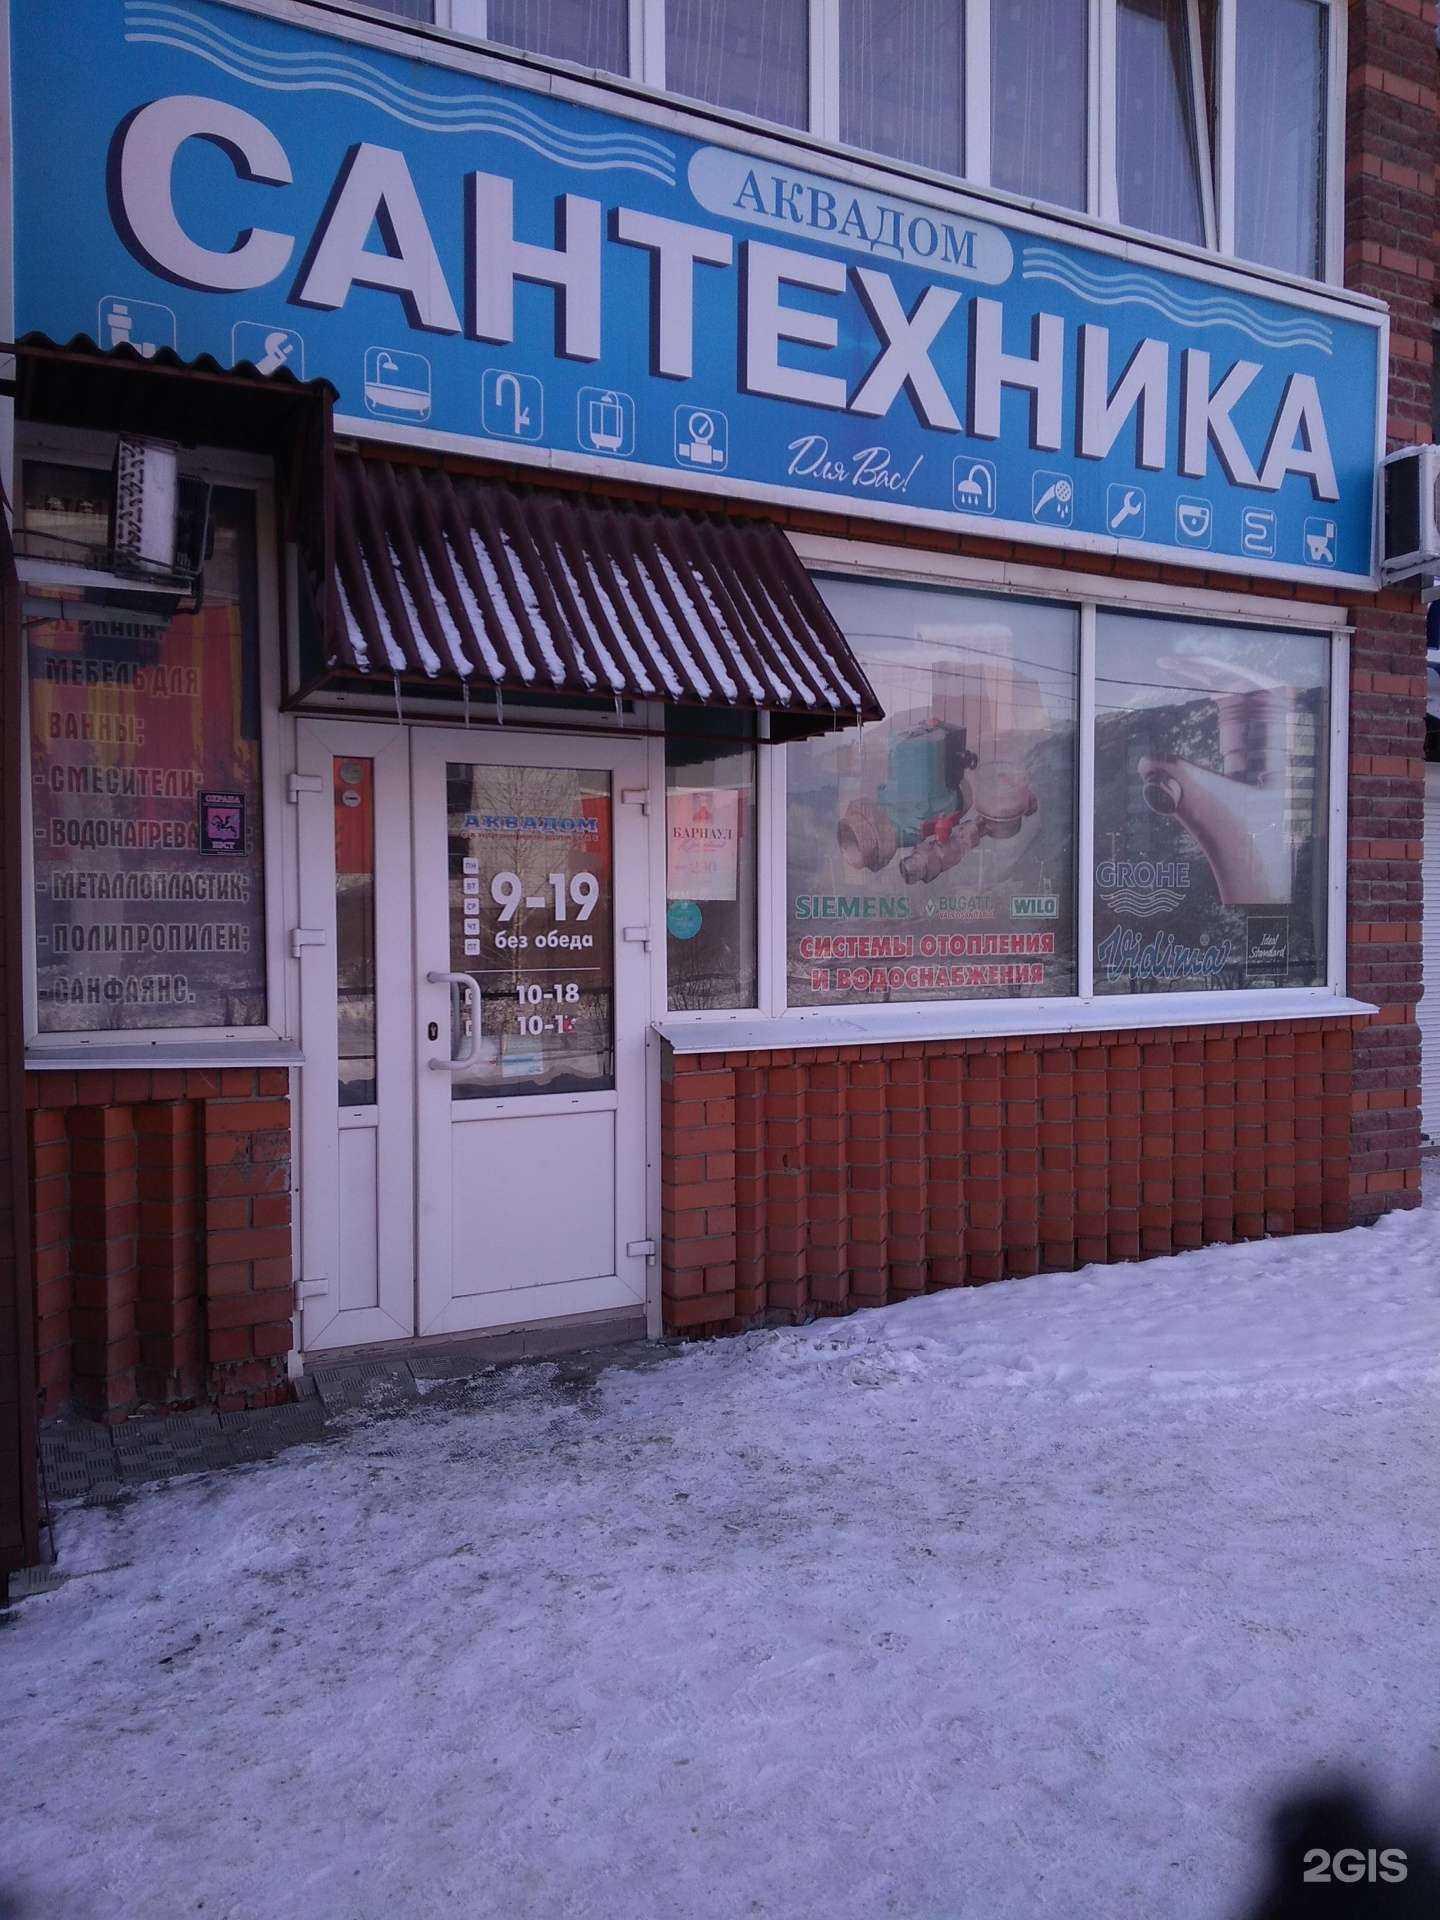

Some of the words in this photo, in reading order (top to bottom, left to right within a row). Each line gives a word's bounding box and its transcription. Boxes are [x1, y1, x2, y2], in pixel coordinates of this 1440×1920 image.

[733, 169, 978, 268] АКВАДОМ
[106, 94, 1340, 501] САНТЕХНИКА
[788, 435, 850, 482] Для
[852, 446, 924, 493] Вас!
[46, 657, 145, 693] МЕБЕЛЬ
[149, 664, 202, 698] ДЛЯ
[464, 814, 598, 832] АКВАДОМ
[1096, 861, 1191, 888] GROHE
[491, 872, 599, 921] 9-19
[795, 895, 912, 919] SIEMENS
[1014, 898, 1056, 914] WILO
[495, 930, 528, 949] без
[535, 932, 593, 950] обеда
[800, 935, 913, 959] СИСТЕМЫ
[920, 933, 1055, 957] ОТОПЛЕНИЯ
[811, 968, 830, 991] И
[836, 963, 1044, 992] ВОДОСНАБЖЕНИЯ
[516, 983, 580, 1004] 10-18
[518, 1015, 576, 1035] 10-1
